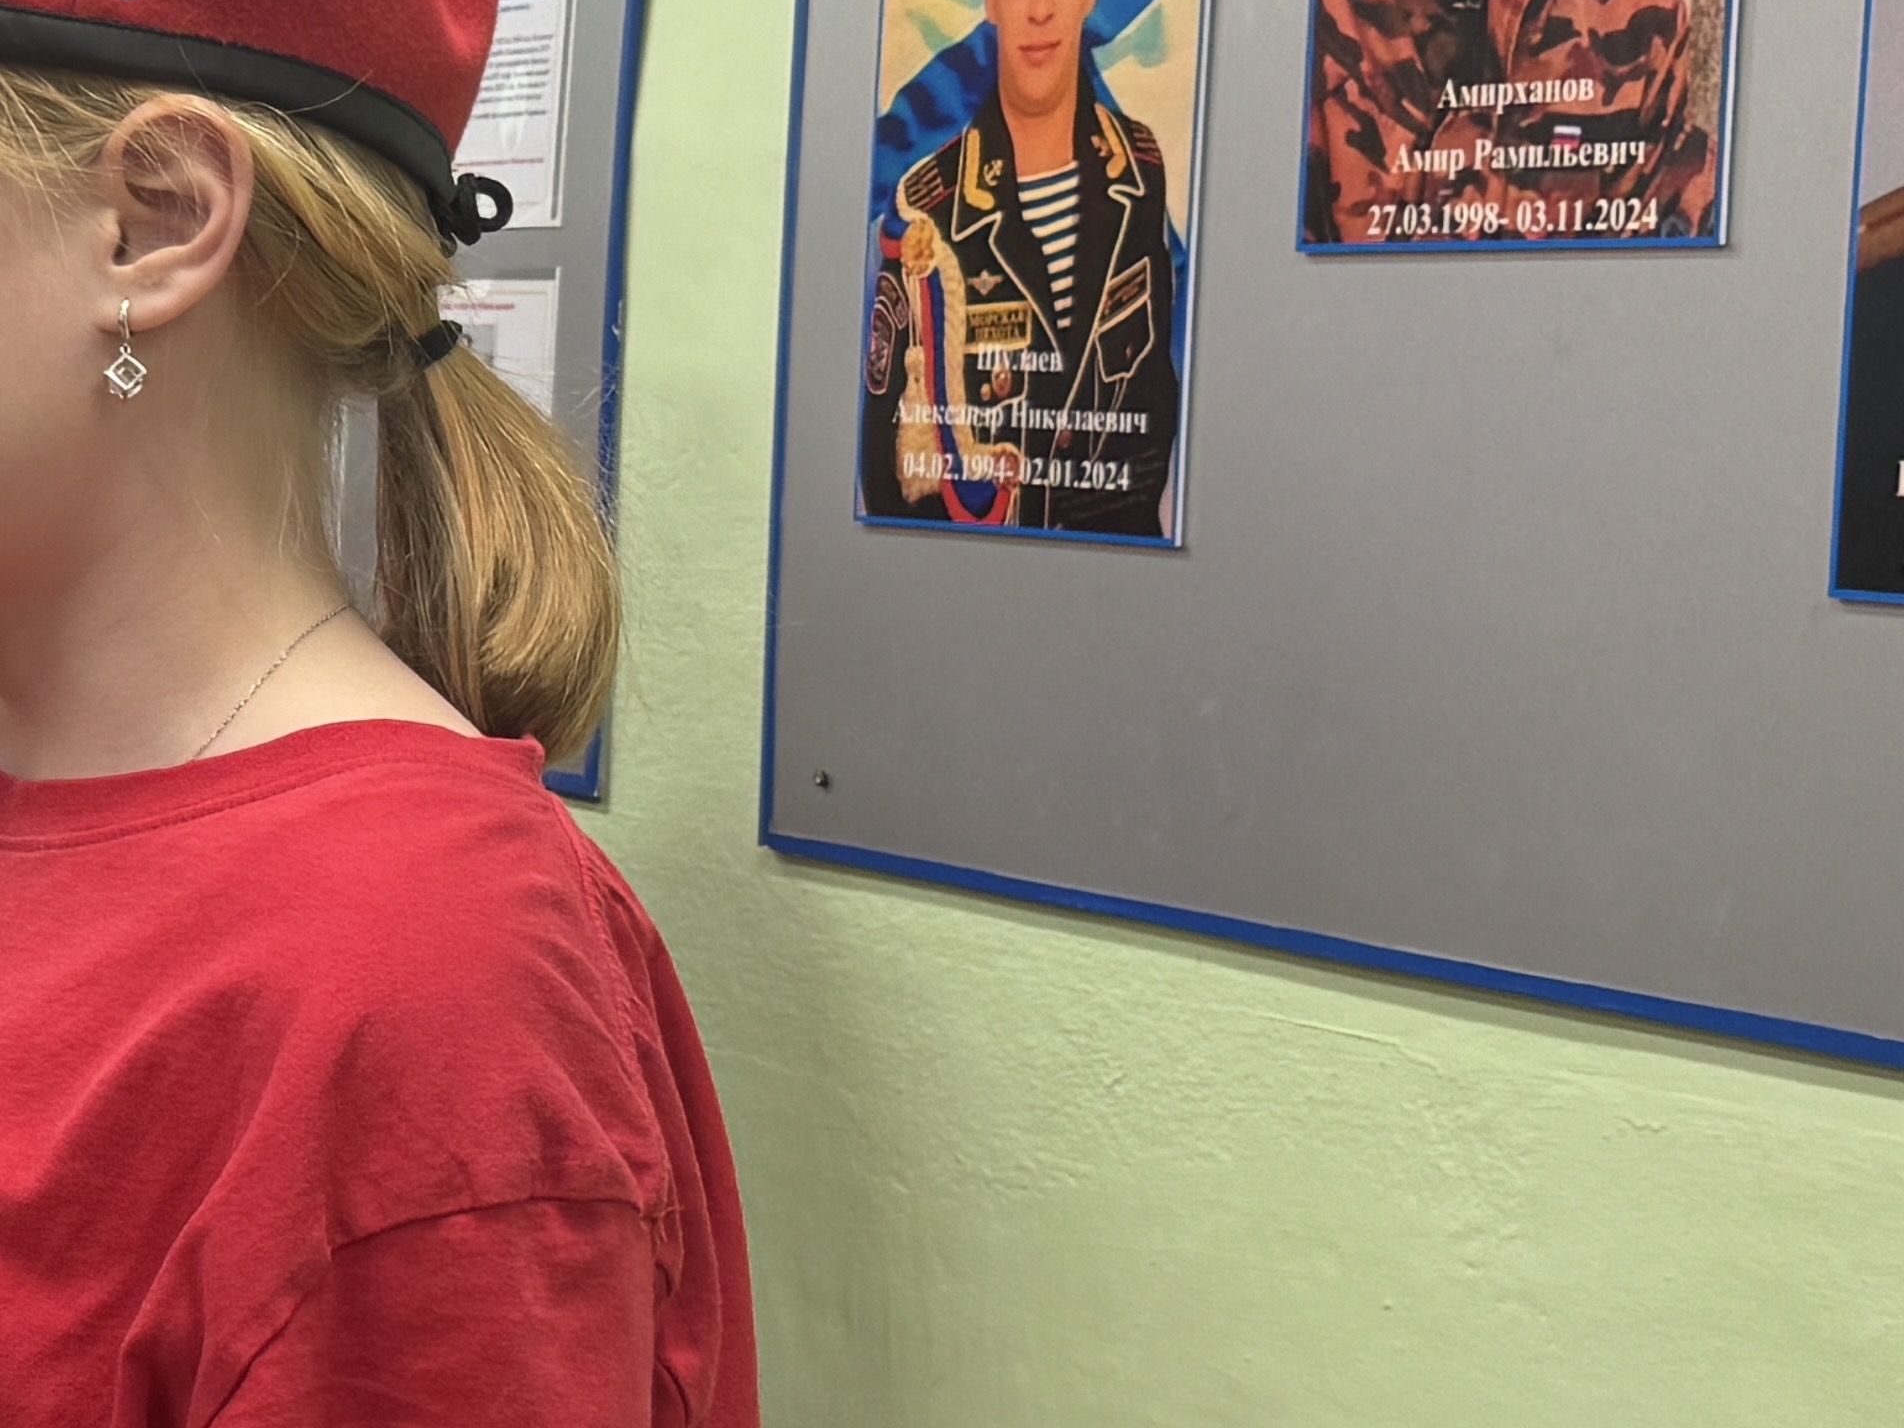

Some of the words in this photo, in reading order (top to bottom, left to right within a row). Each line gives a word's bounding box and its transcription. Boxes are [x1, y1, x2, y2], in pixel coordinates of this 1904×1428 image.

[1436, 77, 1595, 115] Амирханов
[1391, 143, 1466, 181] Амир
[1473, 138, 1647, 172] Рамильевич
[1516, 197, 1659, 233] 03.11.2024
[1018, 456, 1131, 492] 02.01.2024
